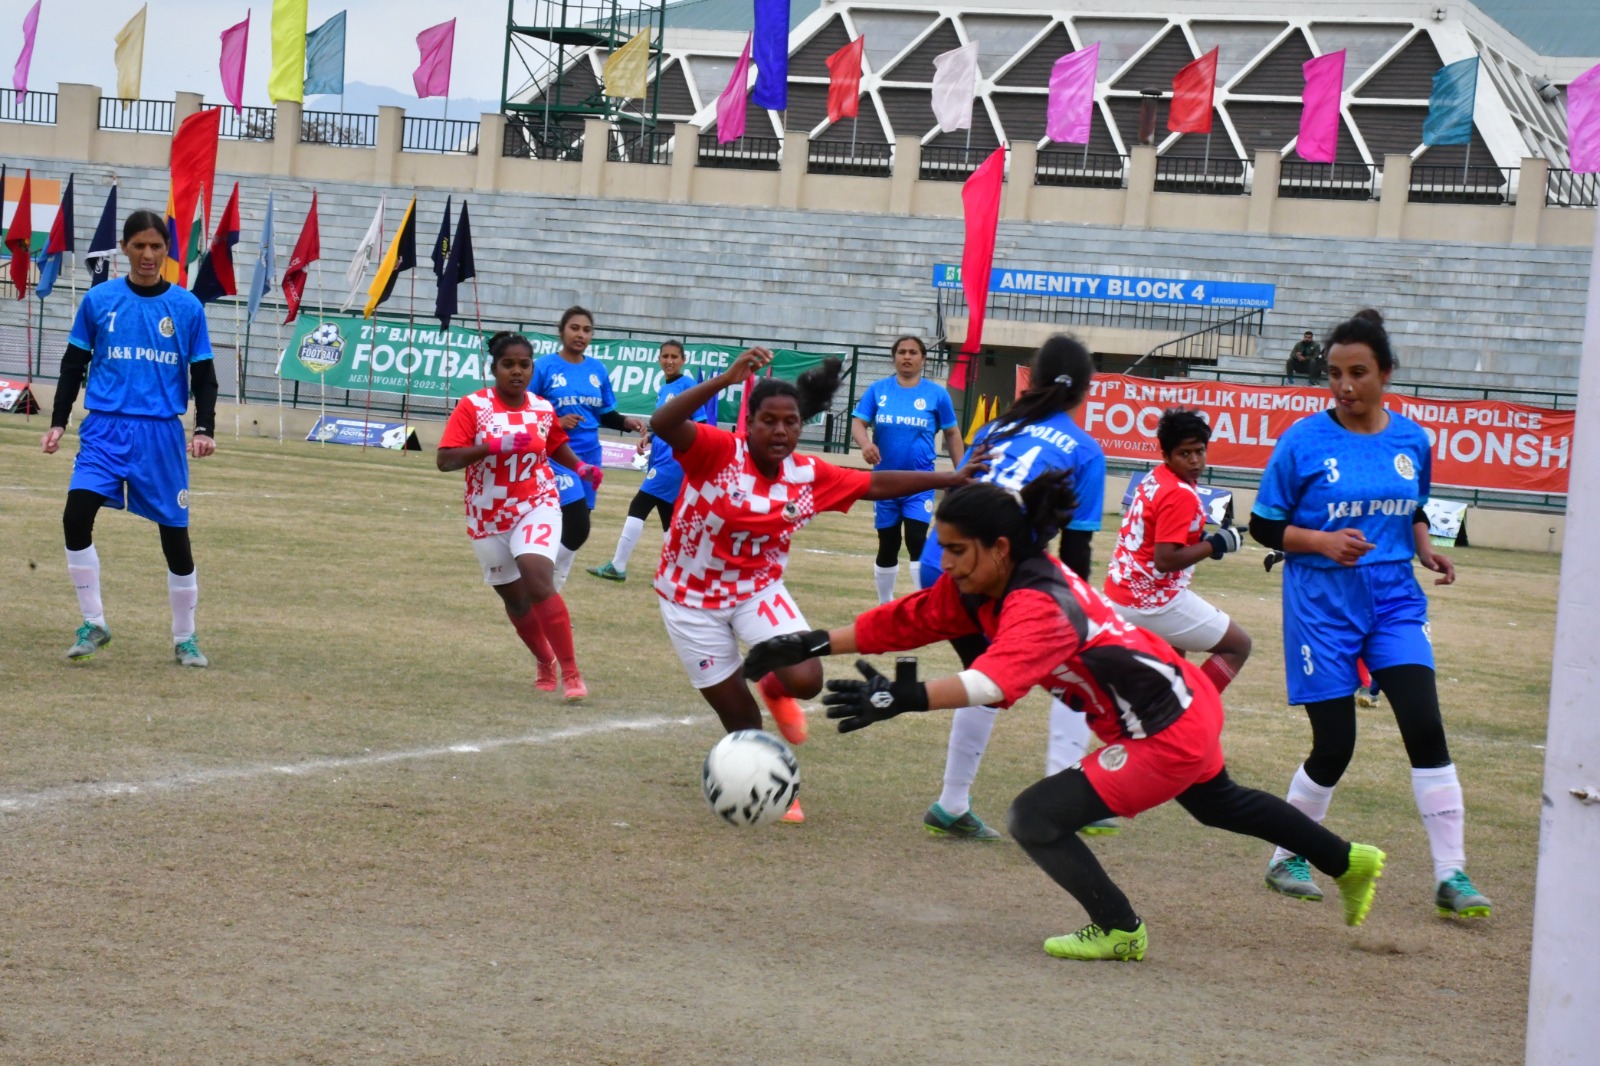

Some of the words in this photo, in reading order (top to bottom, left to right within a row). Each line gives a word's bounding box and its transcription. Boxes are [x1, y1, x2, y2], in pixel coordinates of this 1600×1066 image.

[1000, 272, 1102, 296] AMENITY
[1107, 279, 1184, 300] BLOCK
[1191, 285, 1206, 301] 4
[1211, 296, 1238, 305] BAKHSHI
[1239, 298, 1269, 307] STADIUM
[107, 311, 117, 333] 7
[360, 325, 388, 340] 71ST
[388, 327, 417, 343] B.N
[418, 330, 486, 349] MULLIK
[107, 345, 133, 360] J&K
[135, 347, 179, 365] POLICE
[302, 347, 339, 361] FOOTBALL
[351, 343, 496, 381] FOOTBAL
[551, 373, 567, 388] 26
[557, 395, 577, 408] J&K
[878, 394, 887, 407] 2
[1089, 380, 1121, 398] 71ST
[1123, 383, 1156, 402] B.N
[1159, 386, 1235, 408] MULLIK
[1240, 392, 1337, 413] MEMORIA
[1402, 402, 1460, 424] INDIA
[1464, 407, 1543, 430] POLICE
[339, 430, 374, 439] FOOTBALL
[1085, 401, 1279, 447] FOOALL
[503, 452, 537, 483] 12
[1323, 457, 1340, 483] 3
[1326, 501, 1364, 522] J&K
[522, 523, 552, 547] 12
[757, 592, 797, 627] 11
[1300, 644, 1315, 676] 3
